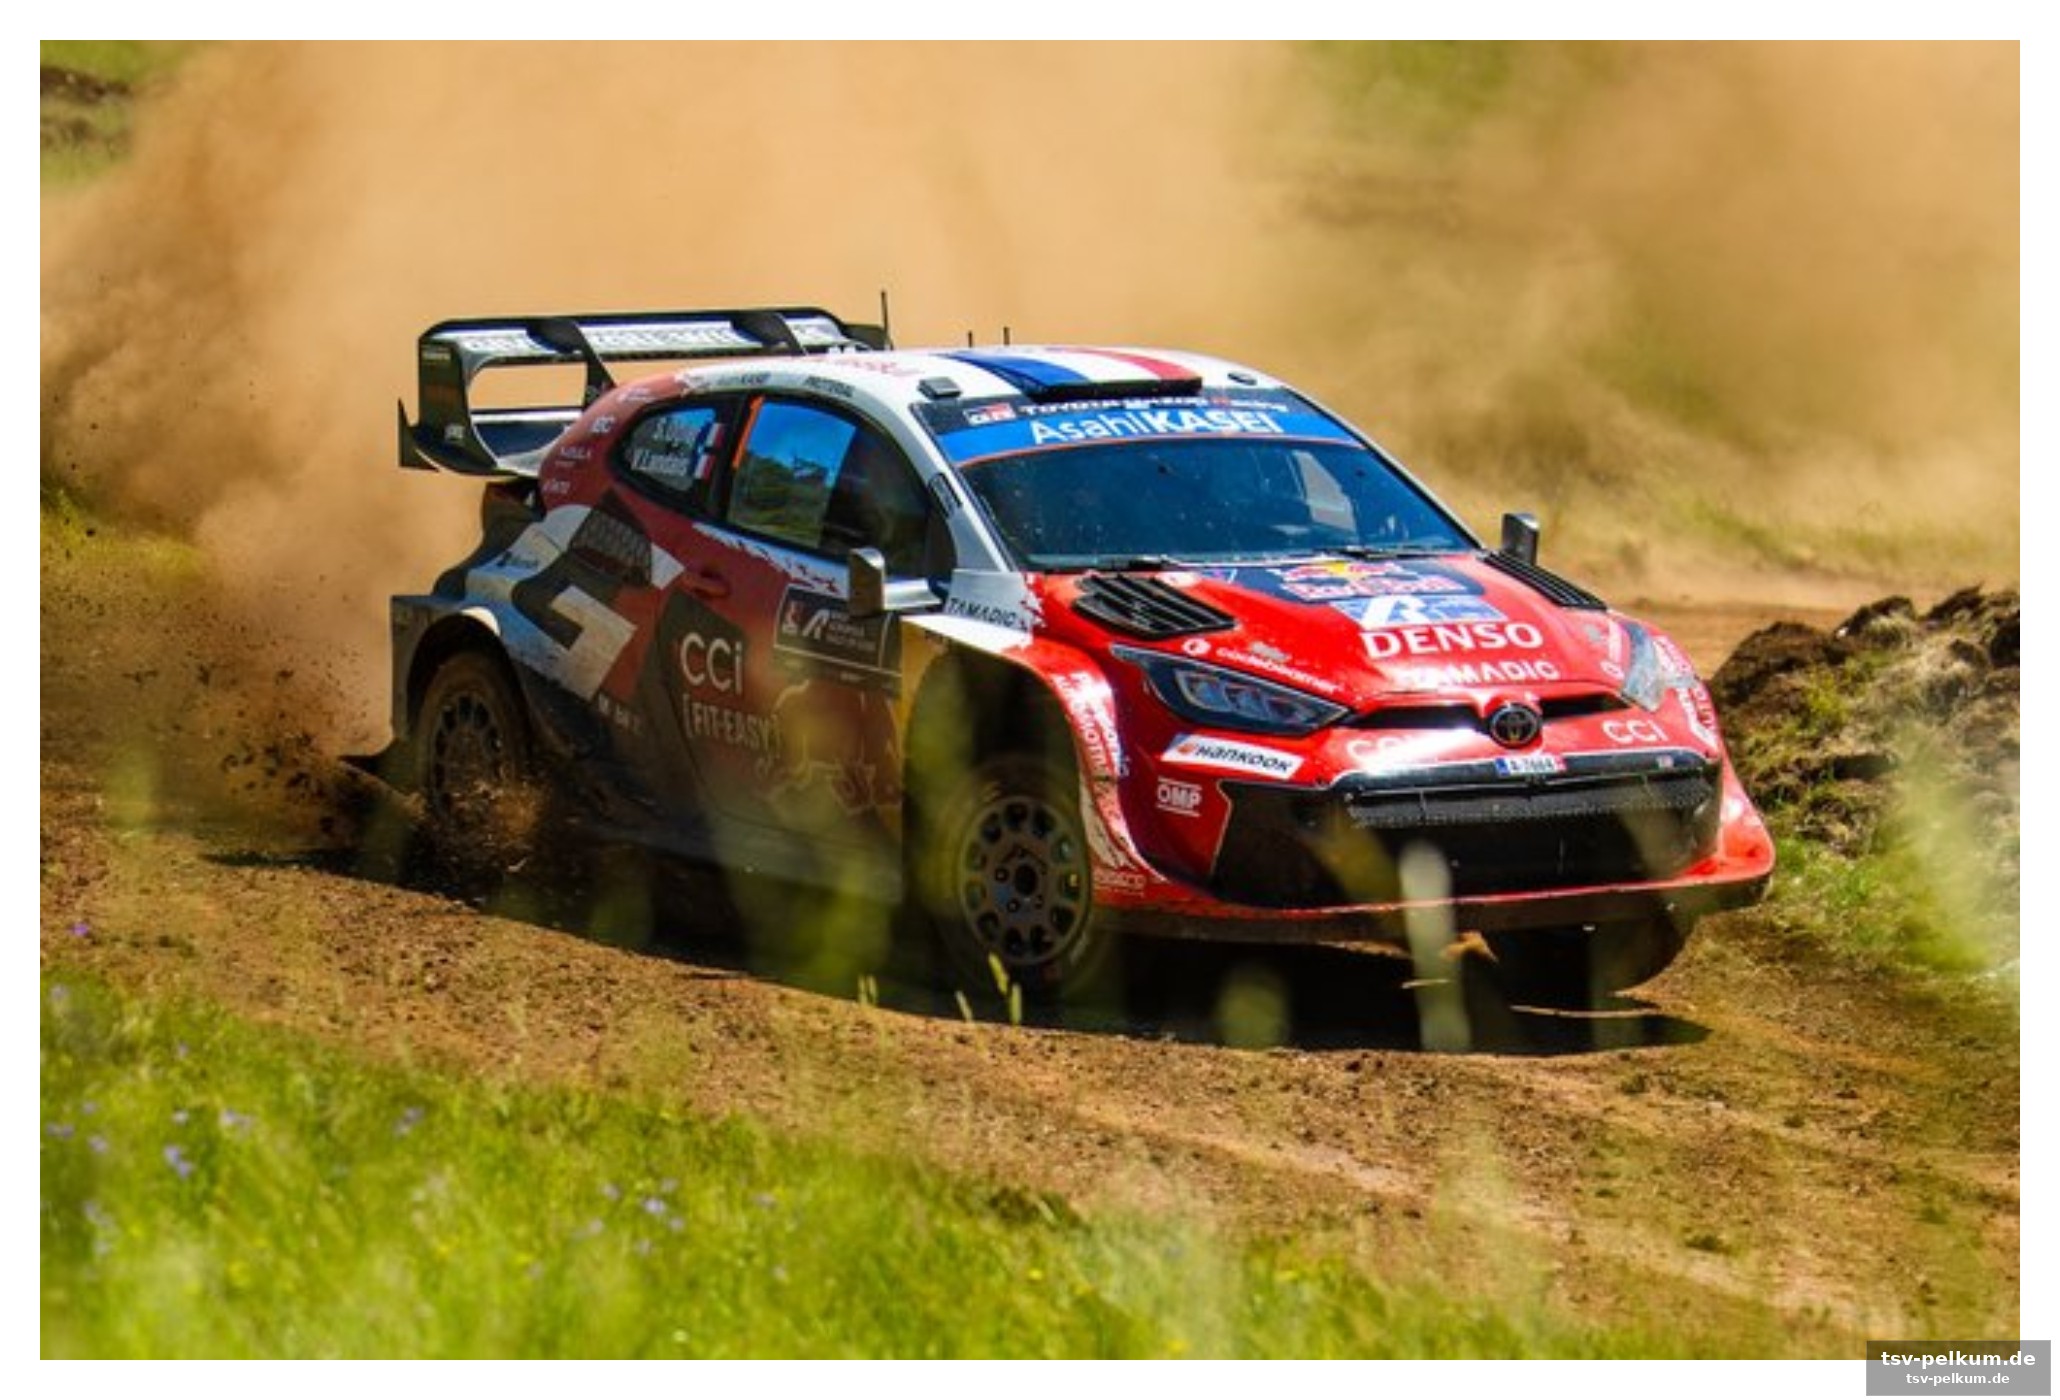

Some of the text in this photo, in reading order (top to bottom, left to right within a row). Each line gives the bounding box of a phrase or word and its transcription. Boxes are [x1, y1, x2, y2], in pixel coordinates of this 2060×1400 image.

[950, 598, 1016, 627] TAMADIC
[1360, 622, 1544, 659] DENSO
[1157, 783, 1202, 810] OMP
